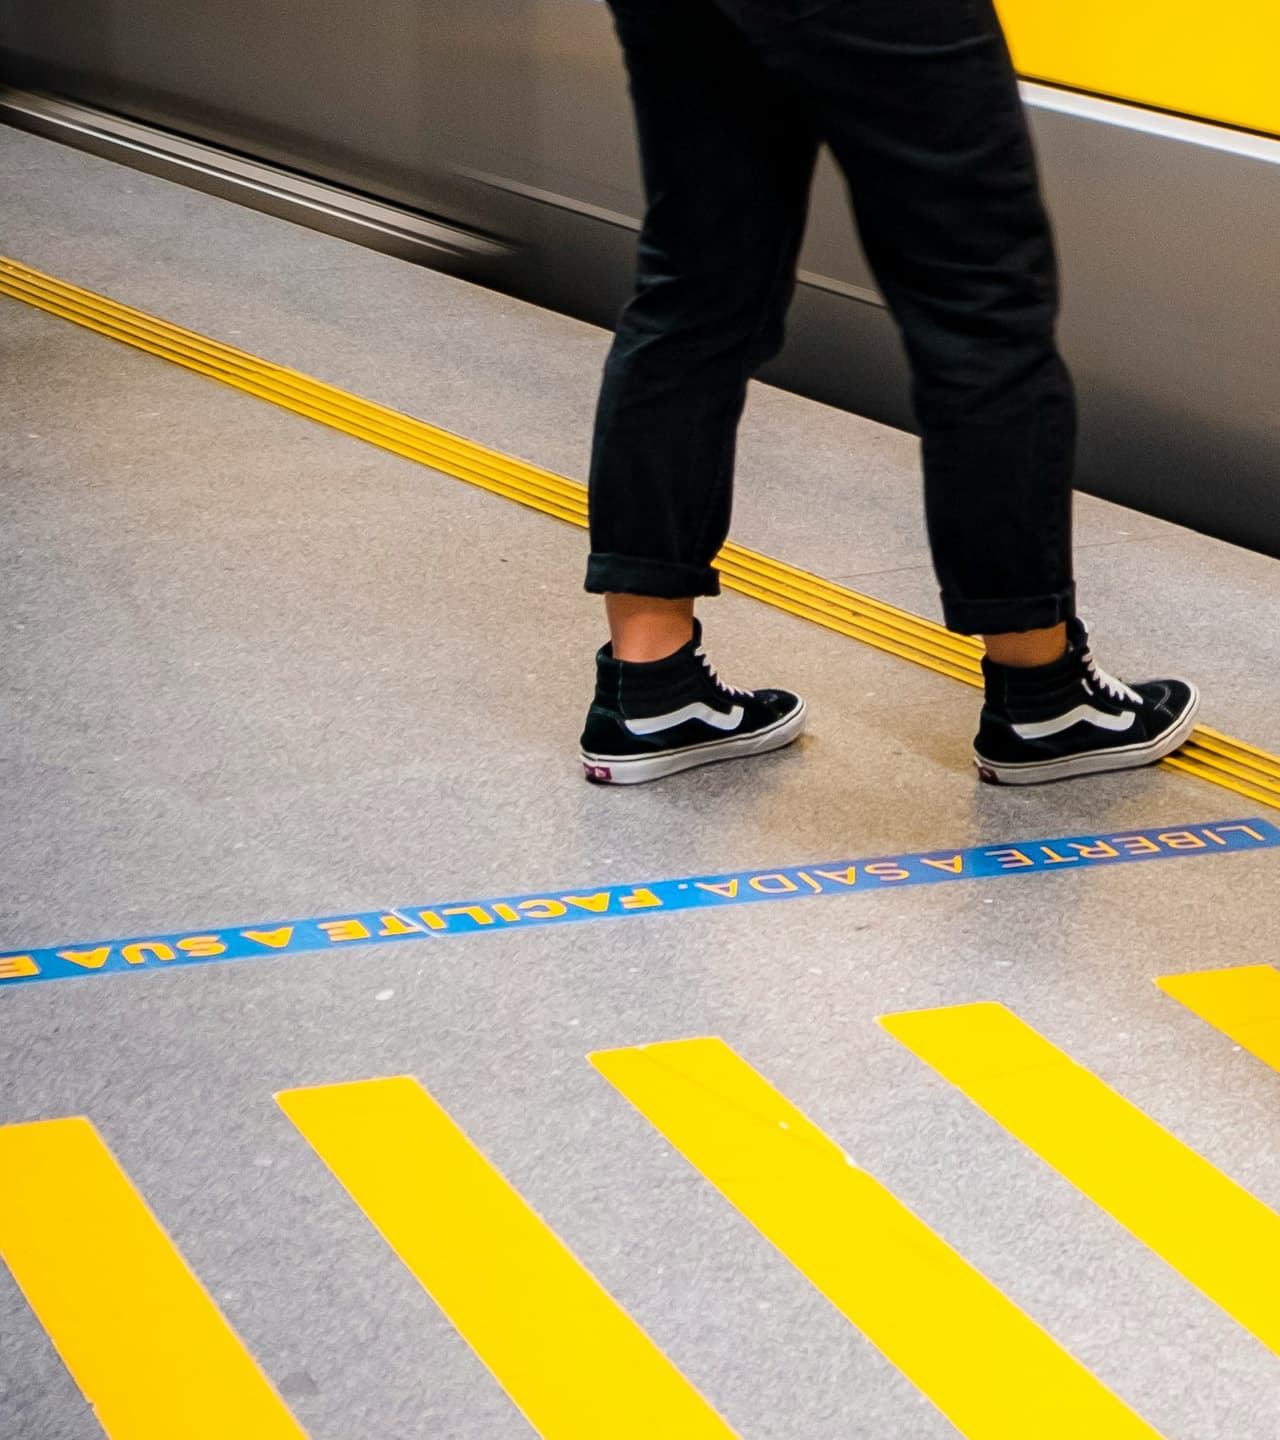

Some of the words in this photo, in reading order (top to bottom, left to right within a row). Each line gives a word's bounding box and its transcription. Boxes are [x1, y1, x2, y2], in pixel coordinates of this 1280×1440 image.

[985, 823, 1267, 869] LIBERTE
[923, 855, 964, 875] A
[318, 887, 663, 942] FACILITE
[56, 935, 226, 970] SUA
[240, 926, 295, 949] A
